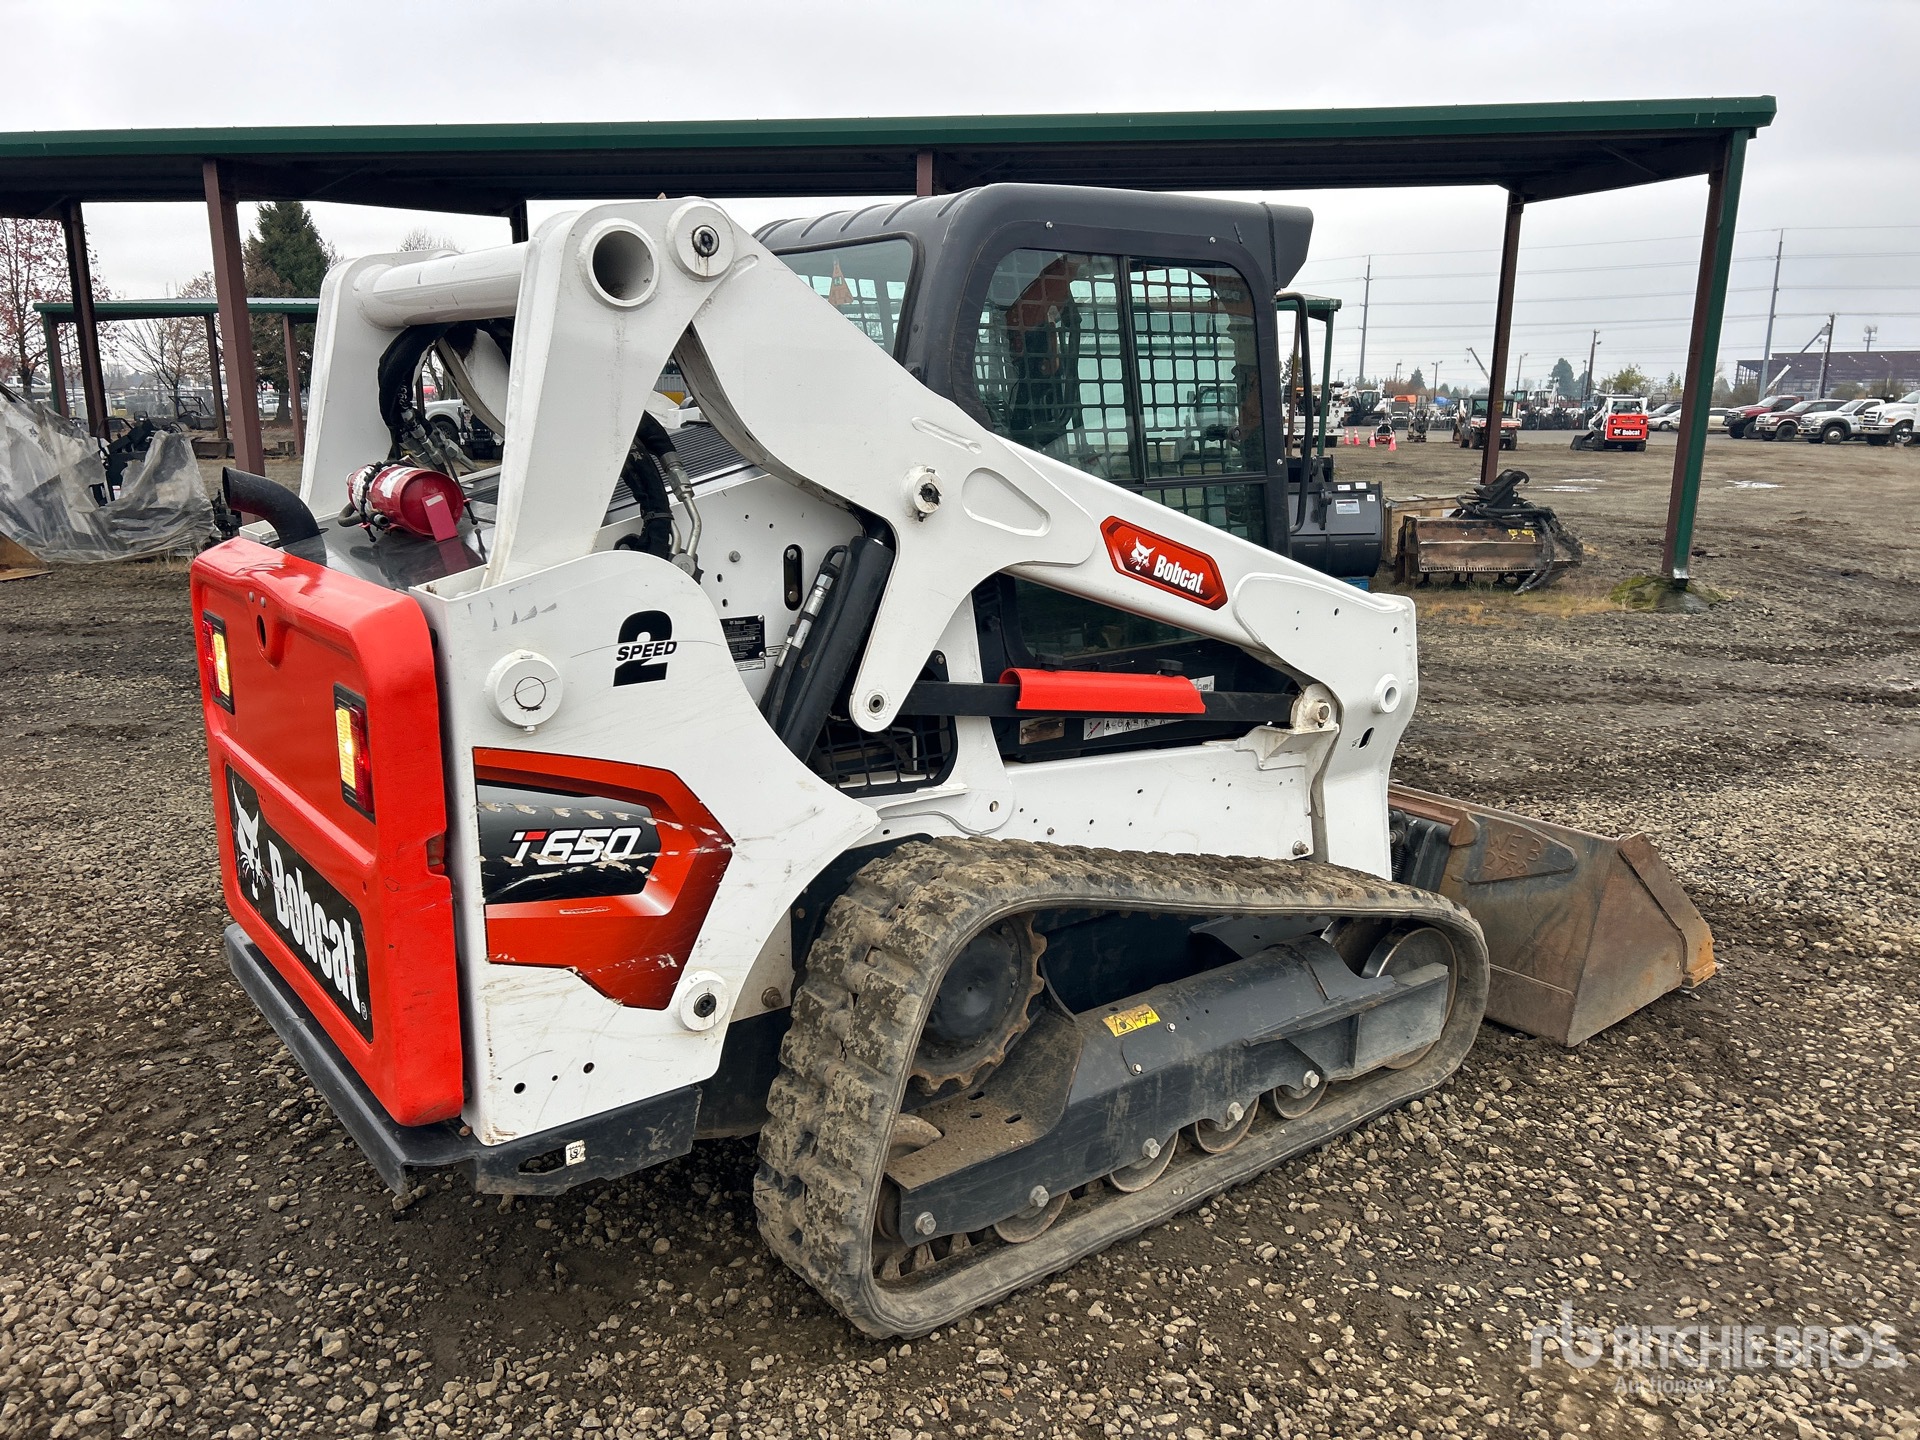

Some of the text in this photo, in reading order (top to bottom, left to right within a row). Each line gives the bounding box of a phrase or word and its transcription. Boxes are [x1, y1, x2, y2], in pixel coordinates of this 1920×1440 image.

[1153, 554, 1204, 594] Bobcat
[613, 609, 672, 687] 2
[616, 641, 677, 662] SPEED
[509, 826, 642, 868] T650
[268, 839, 361, 1015] Bobcat
